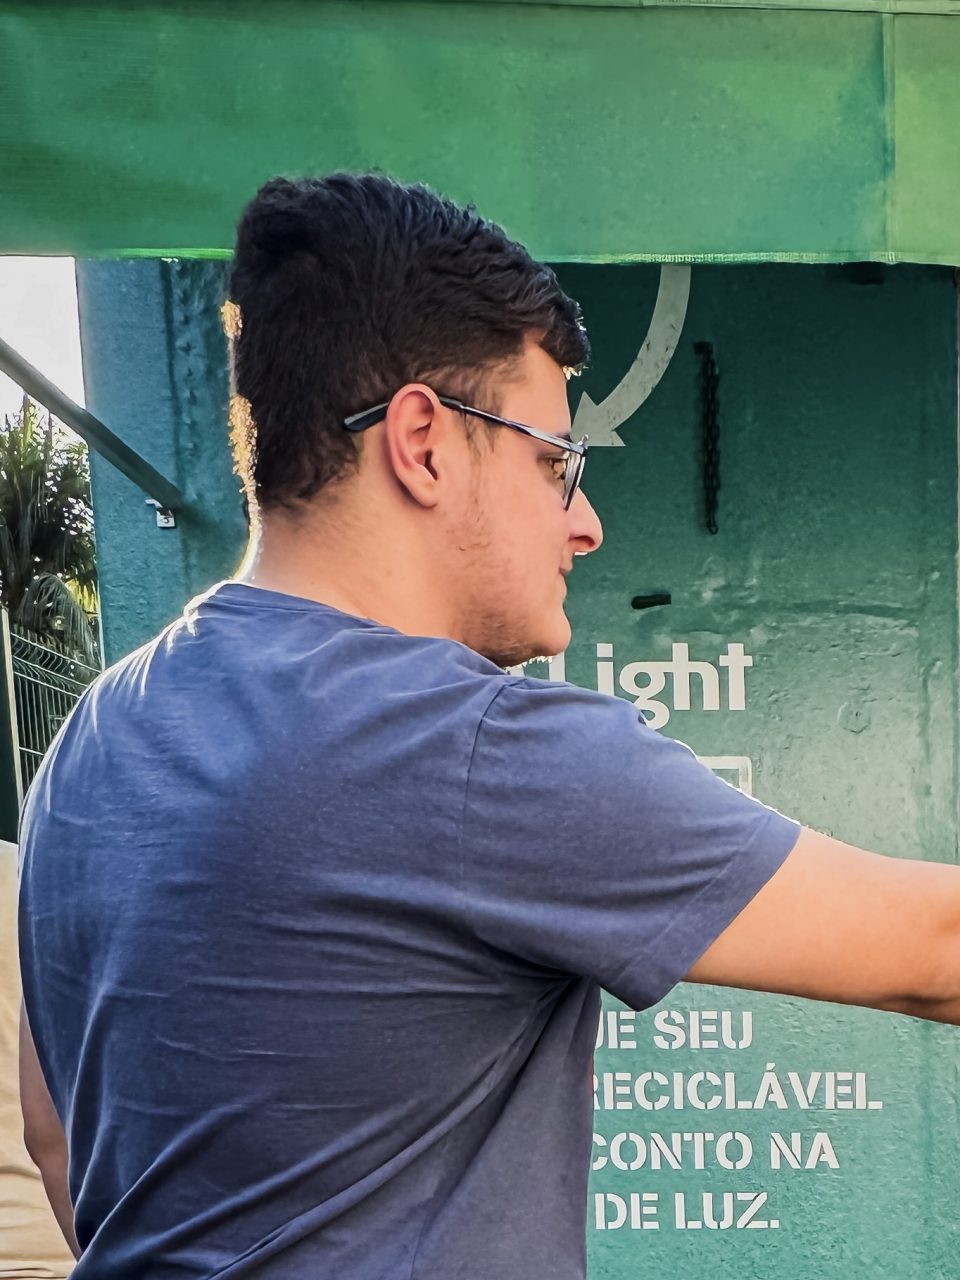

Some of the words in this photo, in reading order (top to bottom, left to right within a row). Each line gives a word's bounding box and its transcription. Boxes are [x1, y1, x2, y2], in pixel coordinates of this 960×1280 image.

[653, 1010, 752, 1049] SEU
[770, 1132, 840, 1170] NA
[595, 1192, 659, 1230] DE
[675, 1192, 780, 1230] LUZ.
